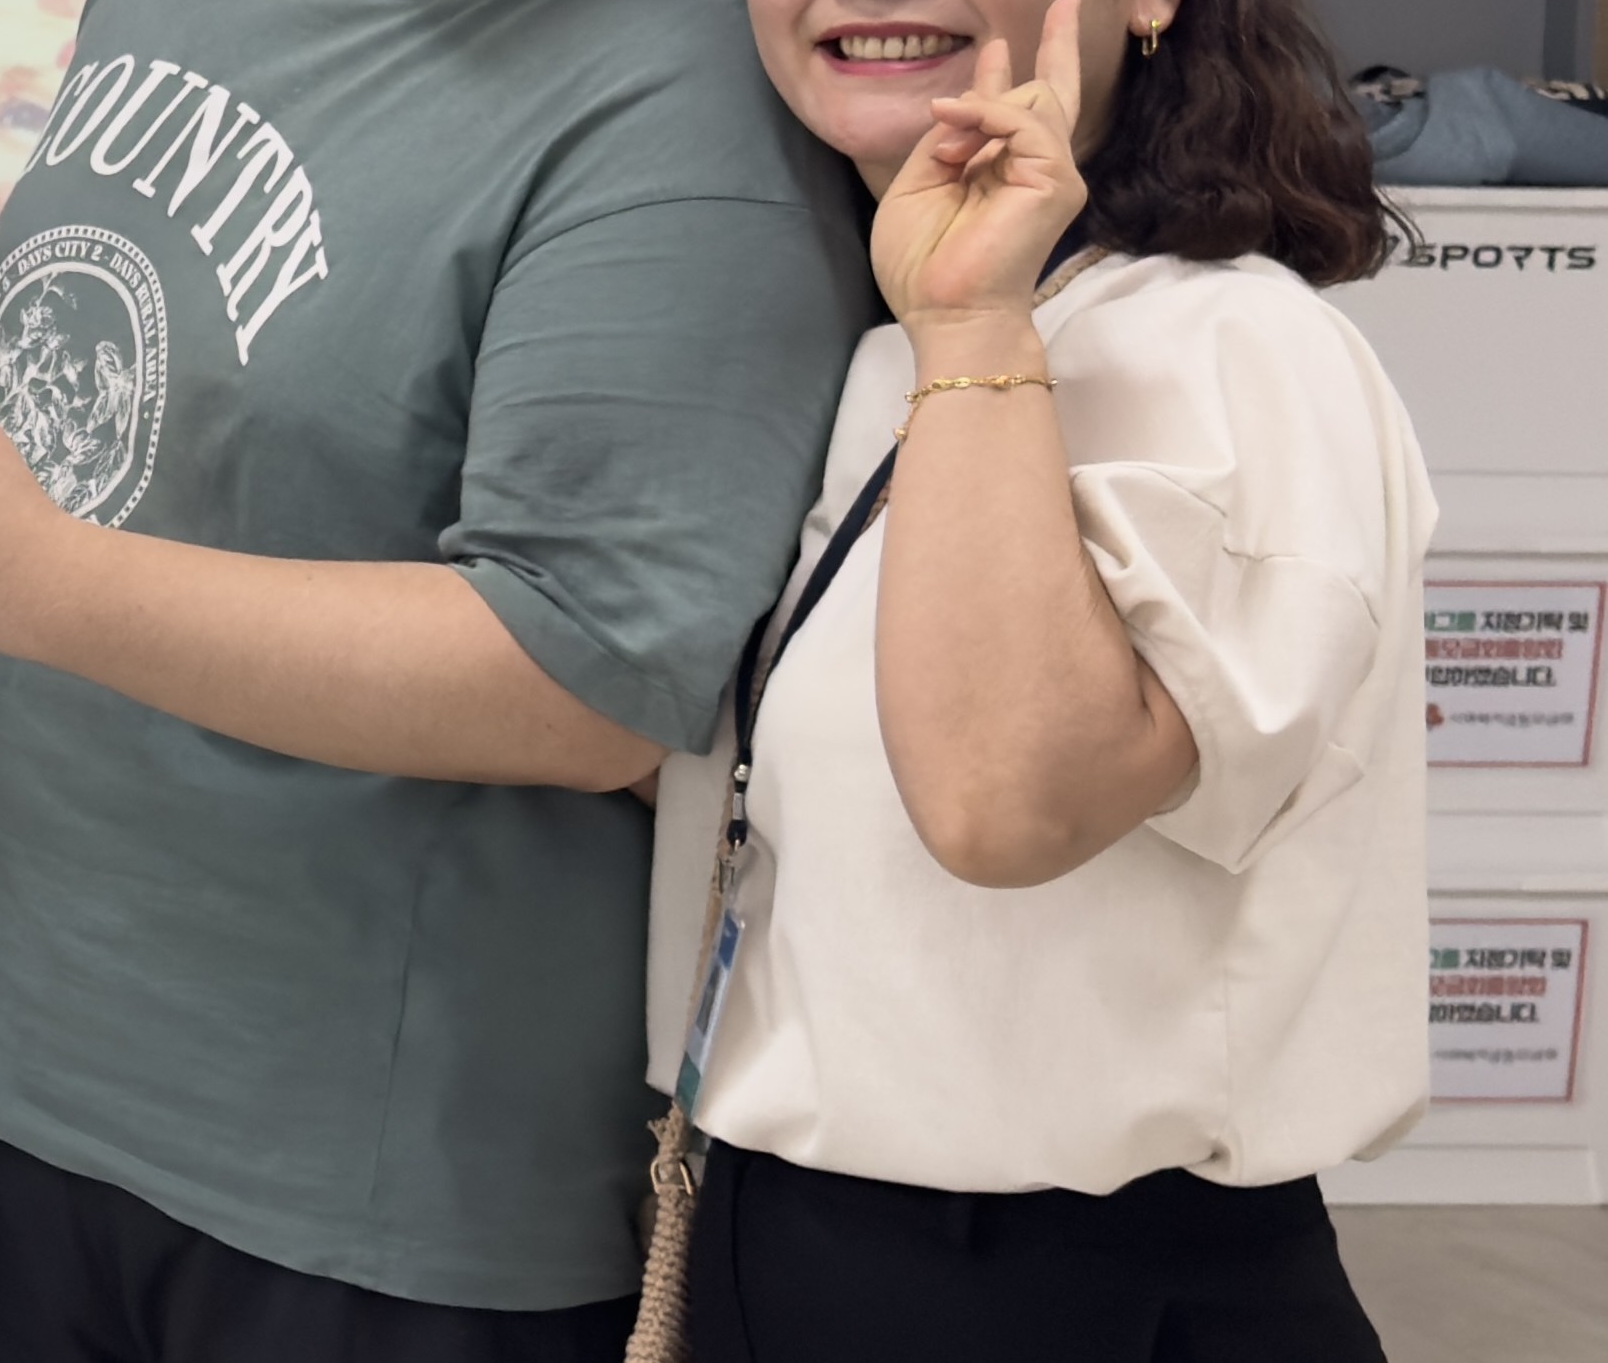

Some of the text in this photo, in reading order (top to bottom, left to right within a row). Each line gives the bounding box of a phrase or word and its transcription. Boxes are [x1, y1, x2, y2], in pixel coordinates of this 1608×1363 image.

[25, 52, 330, 367] COUNTRY
[17, 244, 53, 276] DAYS
[55, 240, 90, 258] CITY
[90, 244, 104, 261] 2
[109, 252, 141, 288] DAYS
[1398, 244, 1597, 272] SPORTS
